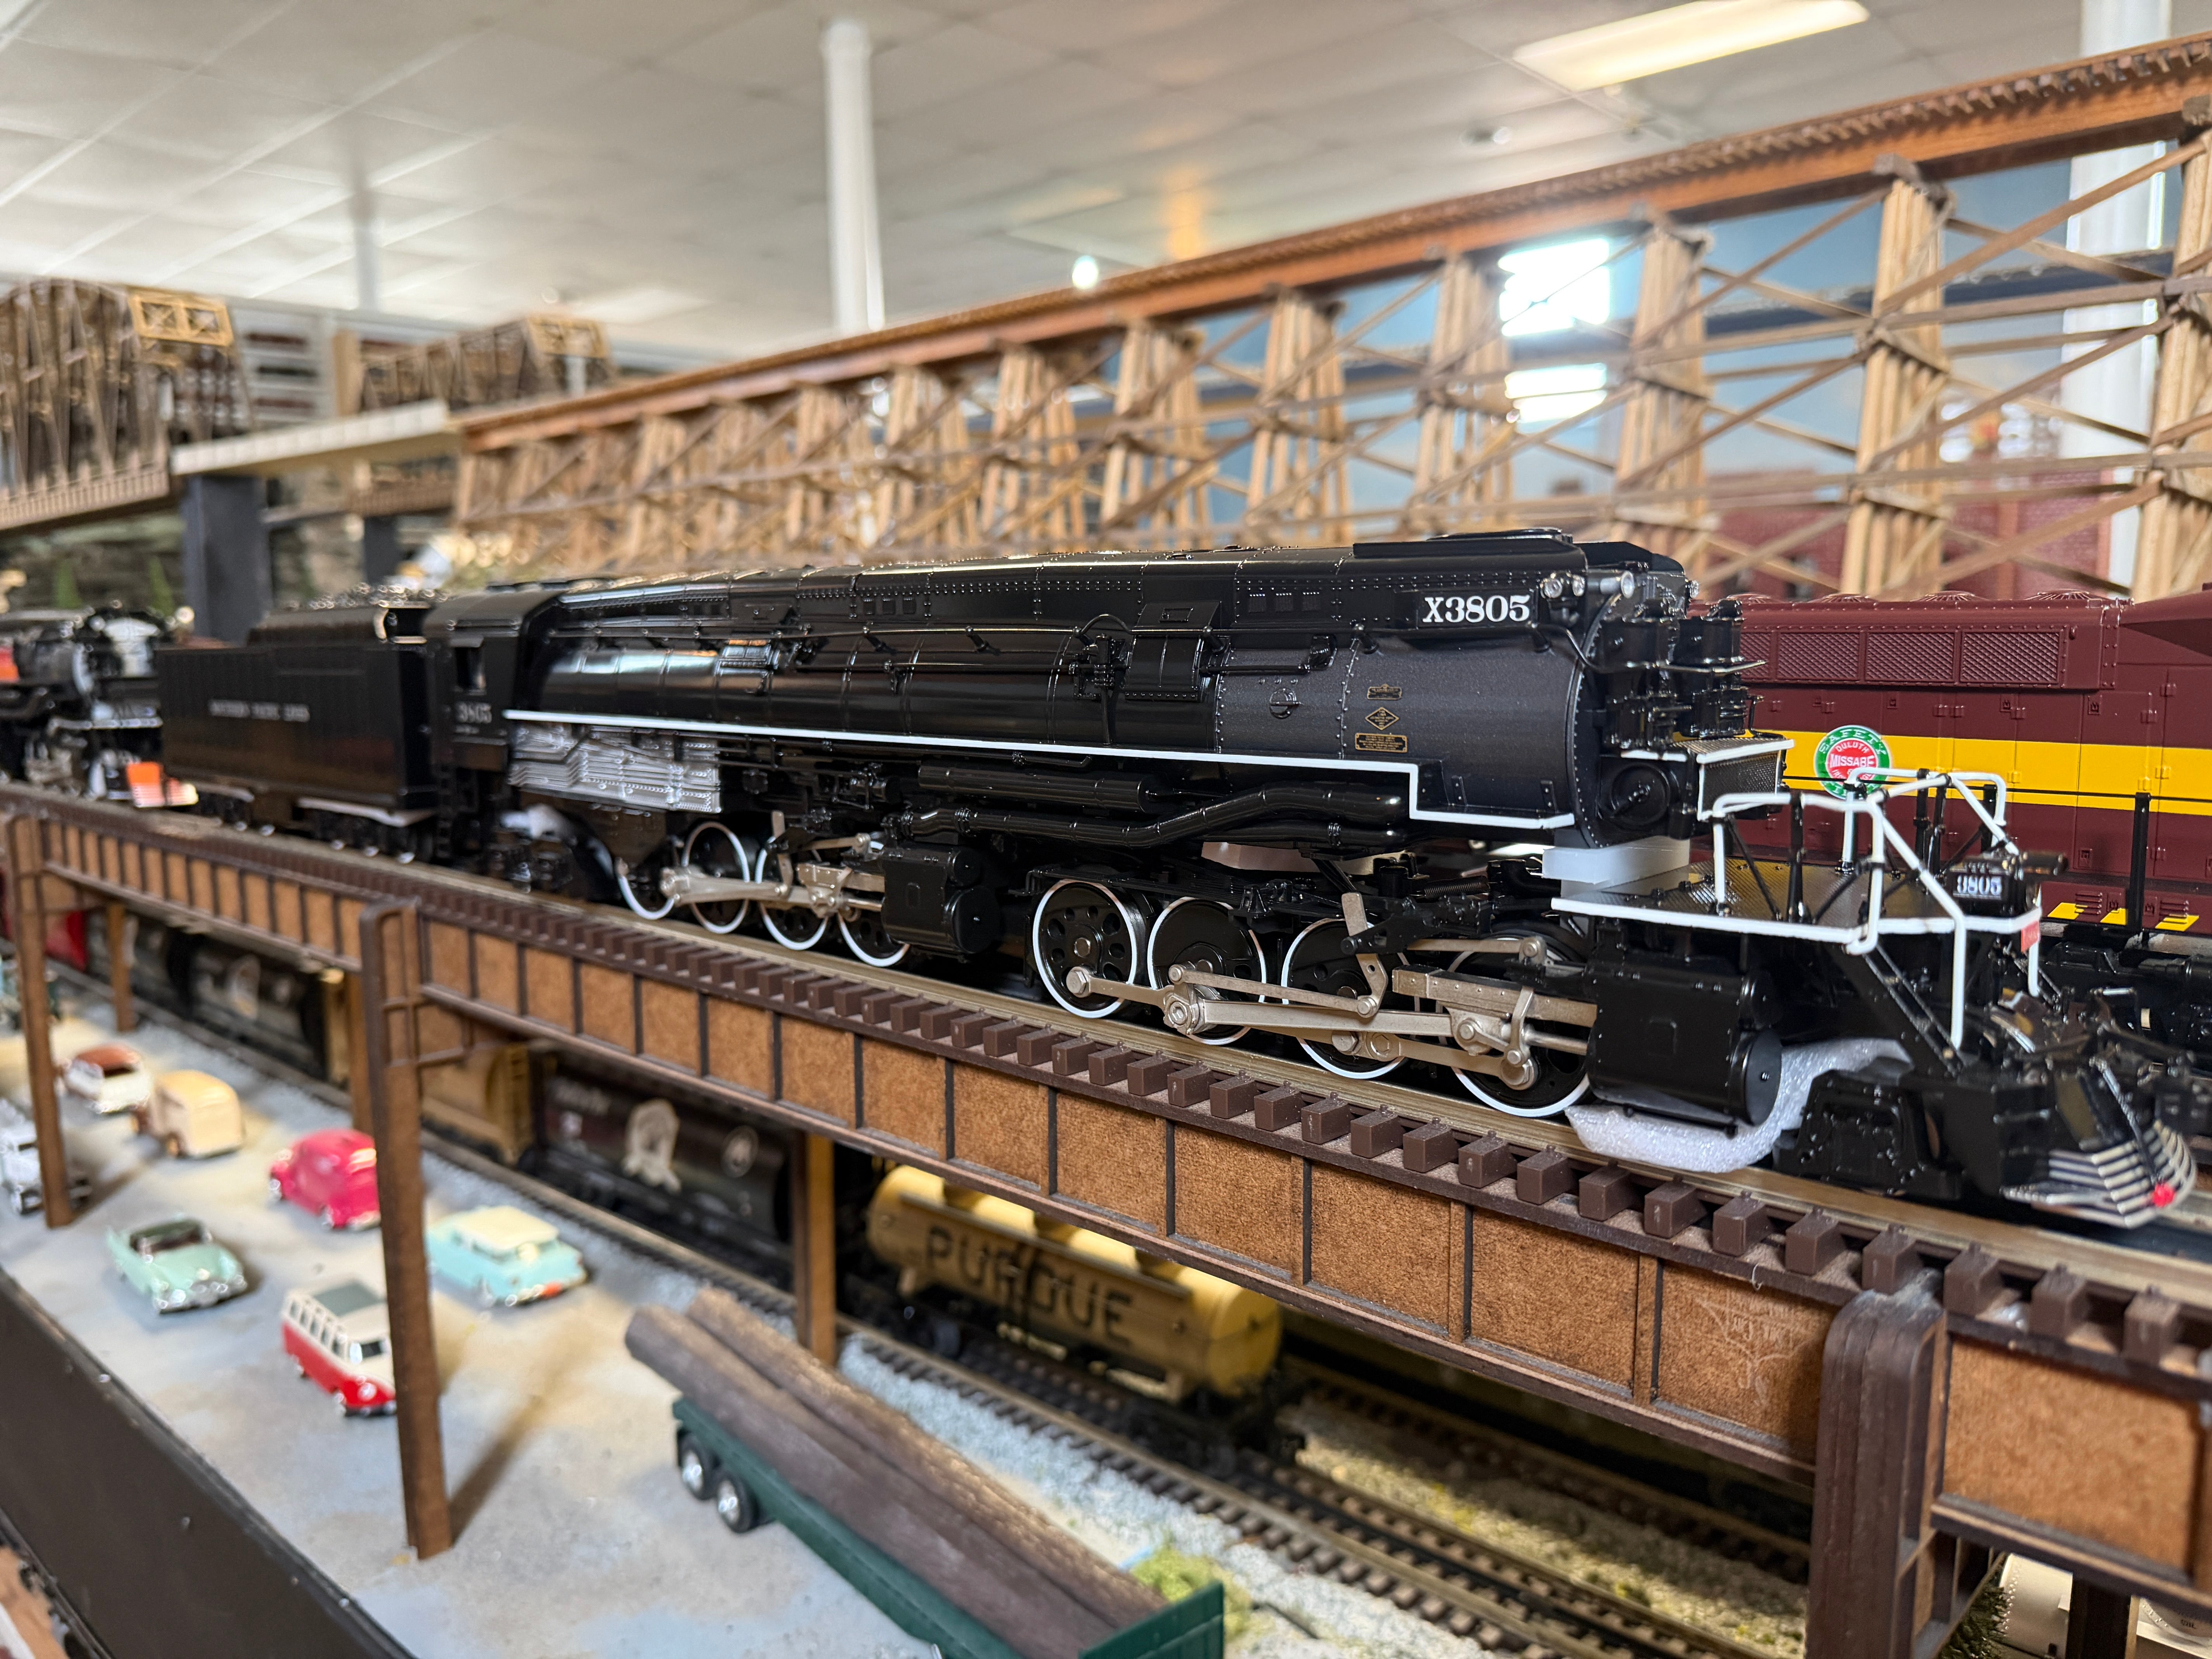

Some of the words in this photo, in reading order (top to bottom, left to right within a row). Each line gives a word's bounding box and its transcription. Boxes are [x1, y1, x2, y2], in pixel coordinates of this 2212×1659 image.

[1422, 595, 1530, 623] X3805
[1819, 728, 1886, 755] SAFETY
[1835, 741, 1870, 753] DULUTH
[1830, 754, 1875, 768] MISSABE
[926, 1226, 1133, 1349] PURDUE
